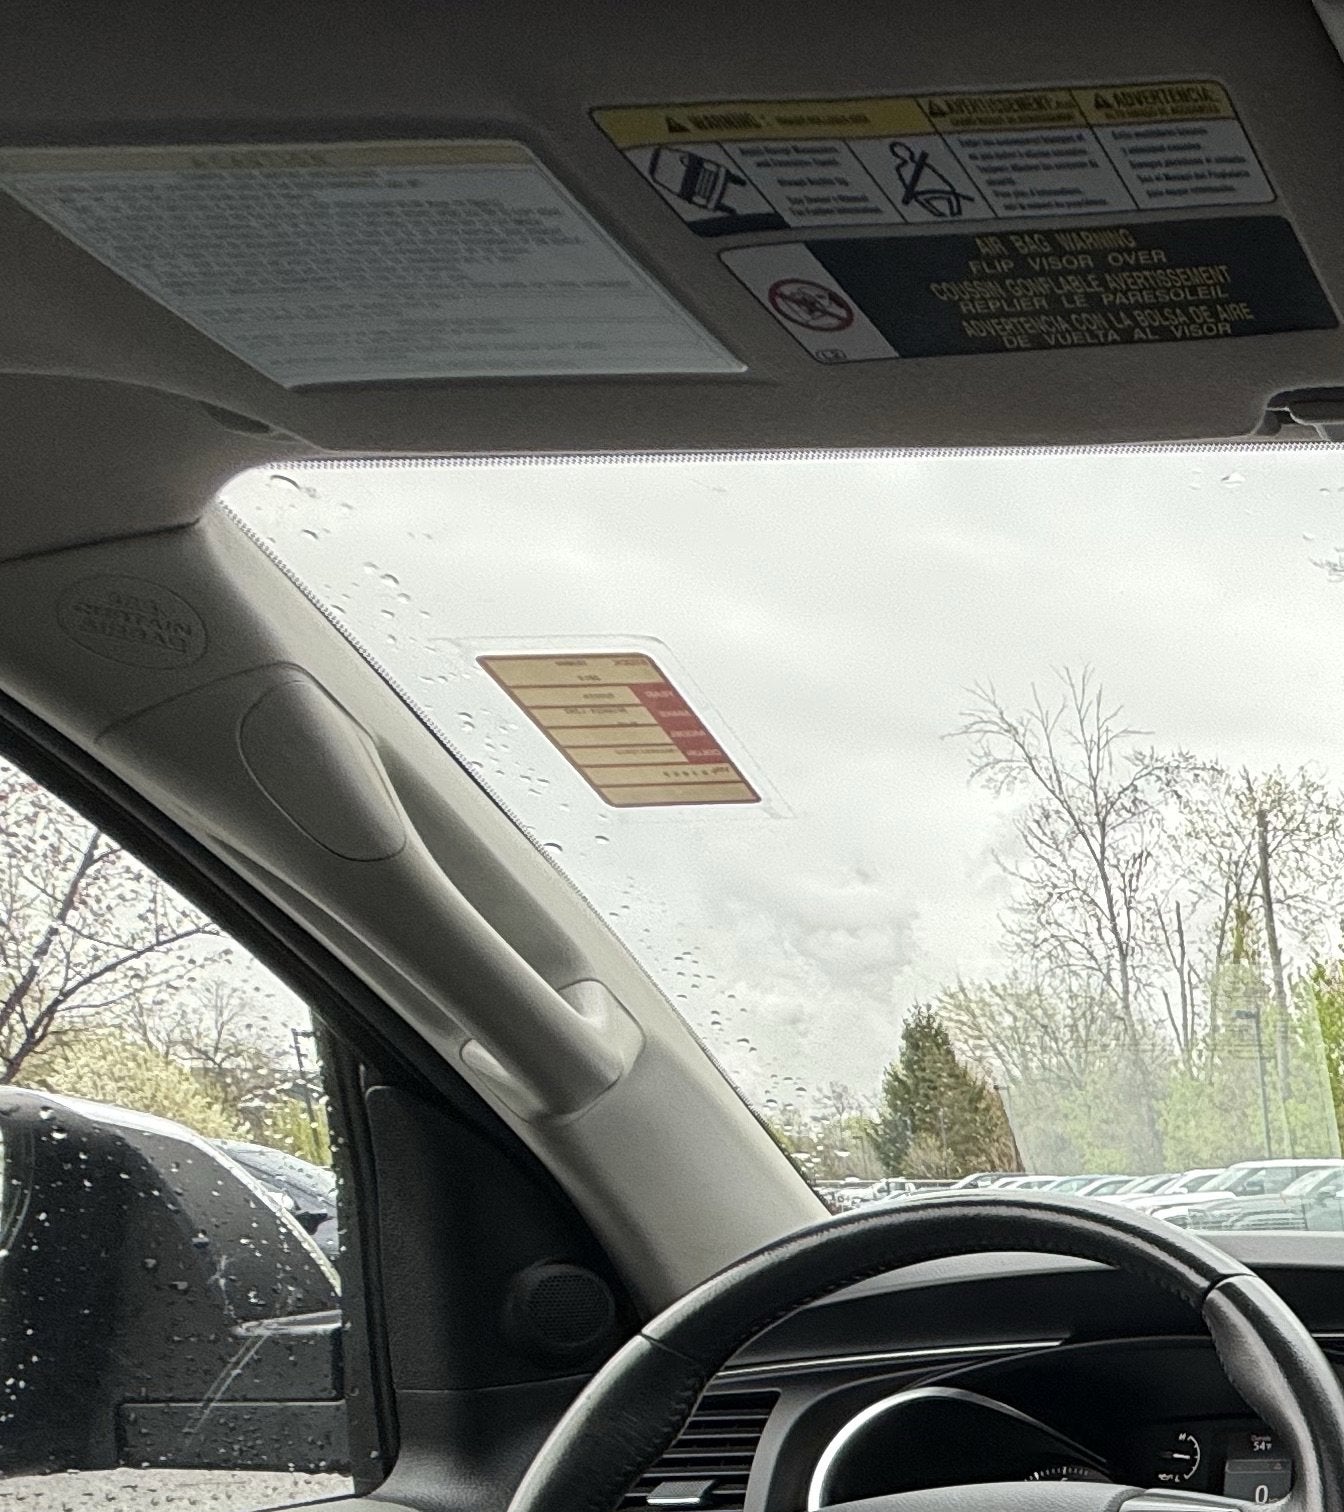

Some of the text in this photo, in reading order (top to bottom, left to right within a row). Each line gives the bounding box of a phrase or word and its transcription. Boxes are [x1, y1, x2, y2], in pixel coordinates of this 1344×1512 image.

[975, 228, 1137, 257] AIR BAG WARNING
[968, 249, 1168, 275] FLIP VISOR OVER
[929, 265, 1232, 302] COUSSIN GONFLABLE AVERTISSEMENT
[960, 285, 1230, 315] REPLIER LE PARESOLEIL
[961, 301, 1255, 338] ADVERTENCIA CON LA BOLSA DE AIRE
[1003, 323, 1232, 349] DE VUELTA AL VISOR
[1255, 1485, 1269, 1504] 0
